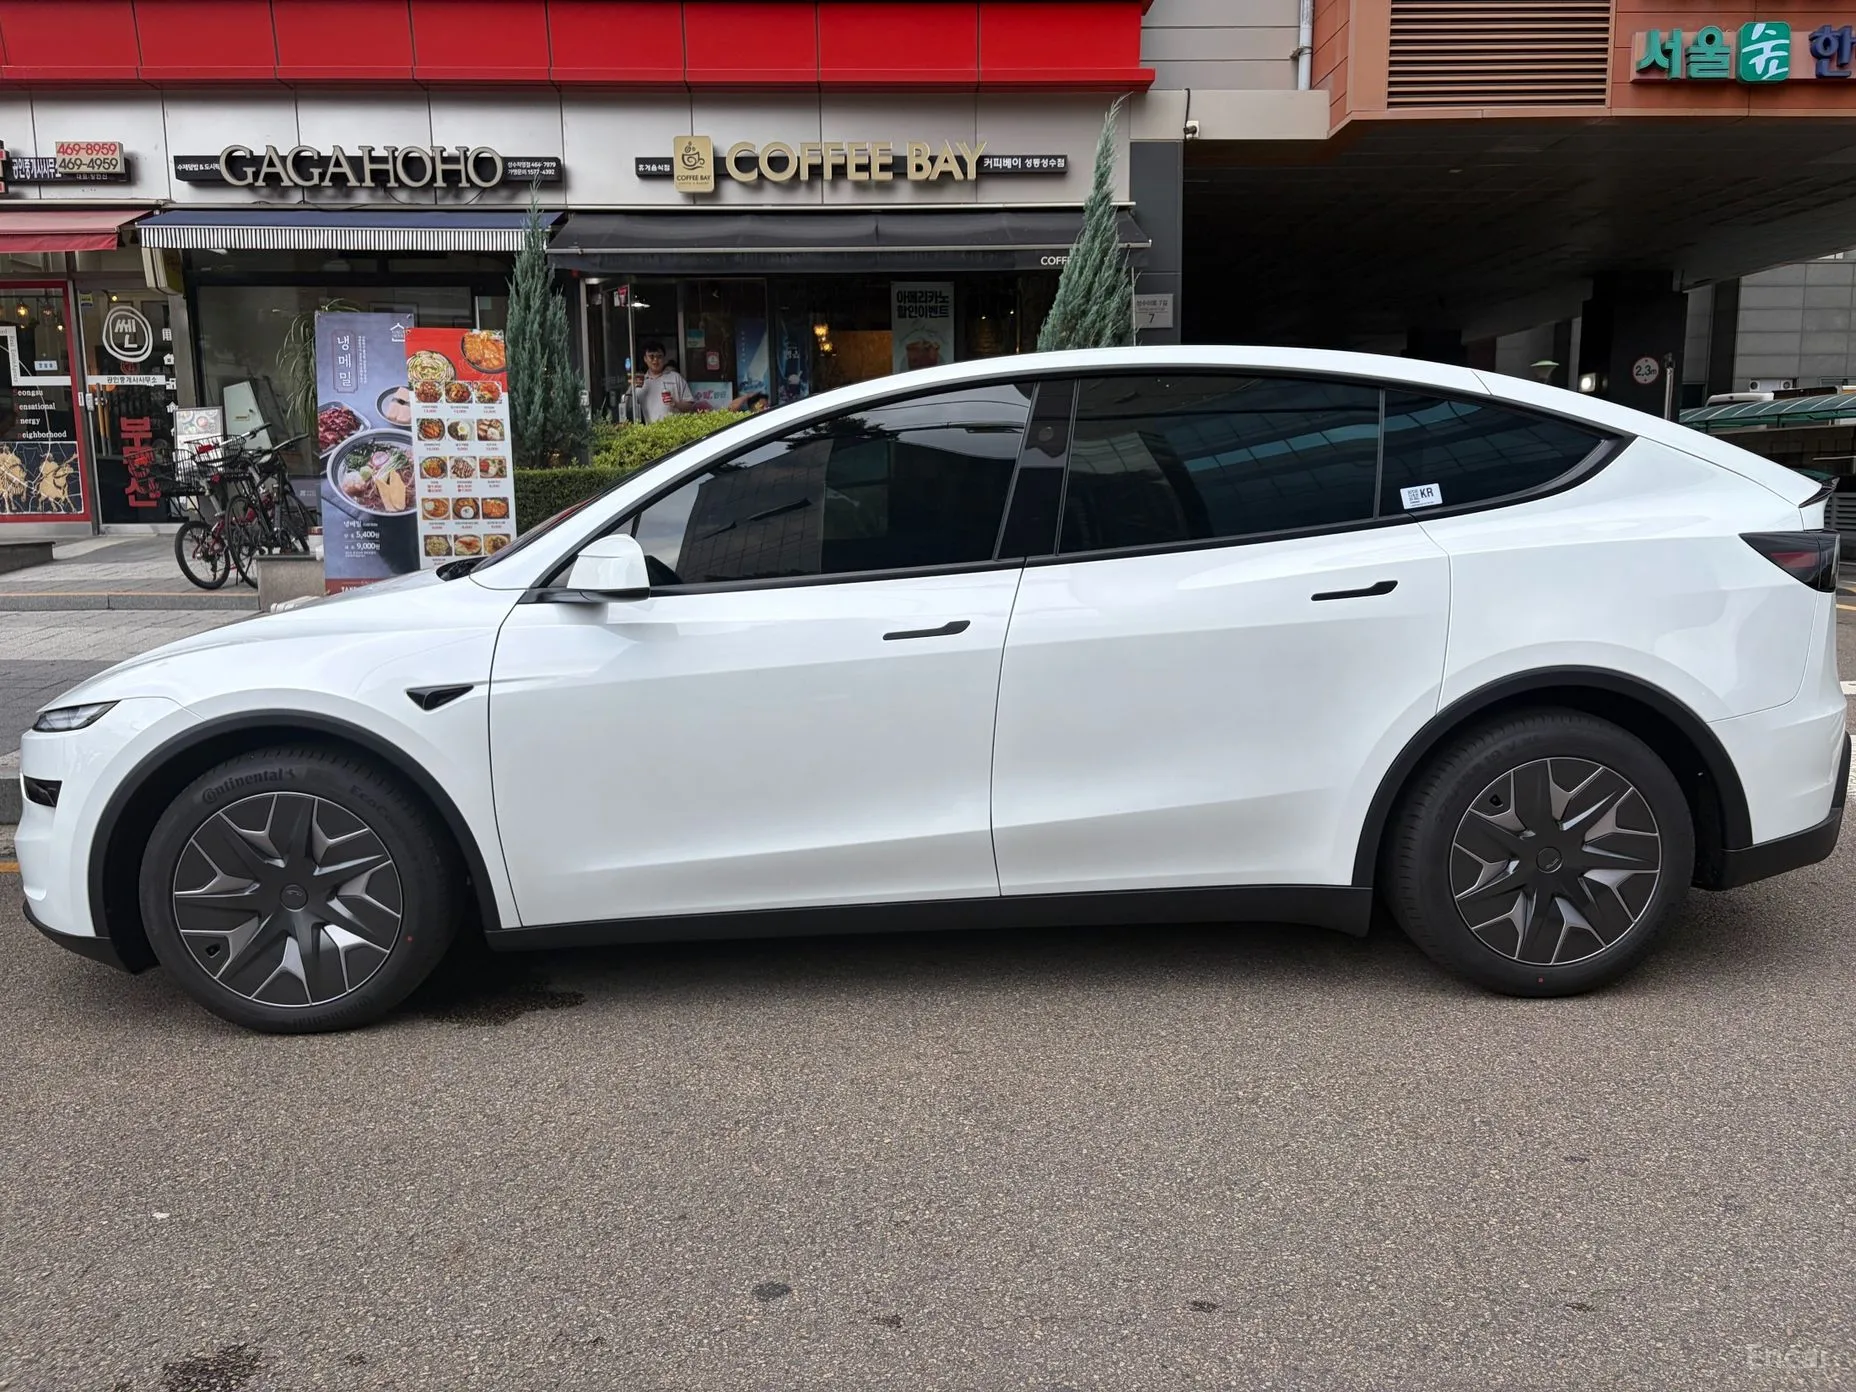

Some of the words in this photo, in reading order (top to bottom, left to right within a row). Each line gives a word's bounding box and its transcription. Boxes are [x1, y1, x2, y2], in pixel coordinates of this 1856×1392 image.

[56, 143, 118, 156] 469-8959
[59, 157, 119, 171] 469-4959
[219, 144, 504, 188] GAGAHOHO
[725, 140, 894, 182] COFFEE
[907, 139, 988, 181] BAY
[983, 157, 1023, 169] 커피베이
[1024, 157, 1066, 168] 성동성수점
[638, 164, 671, 172] 휴게음식점
[676, 174, 699, 182] COFFEE
[700, 174, 711, 182] BAY
[897, 289, 950, 305] 아메리카노
[1148, 313, 1155, 324] 7
[337, 335, 352, 387] 냉메밀
[1635, 364, 1658, 377] 2.3m
[1419, 487, 1434, 499] KR
[202, 767, 284, 804] Continental
